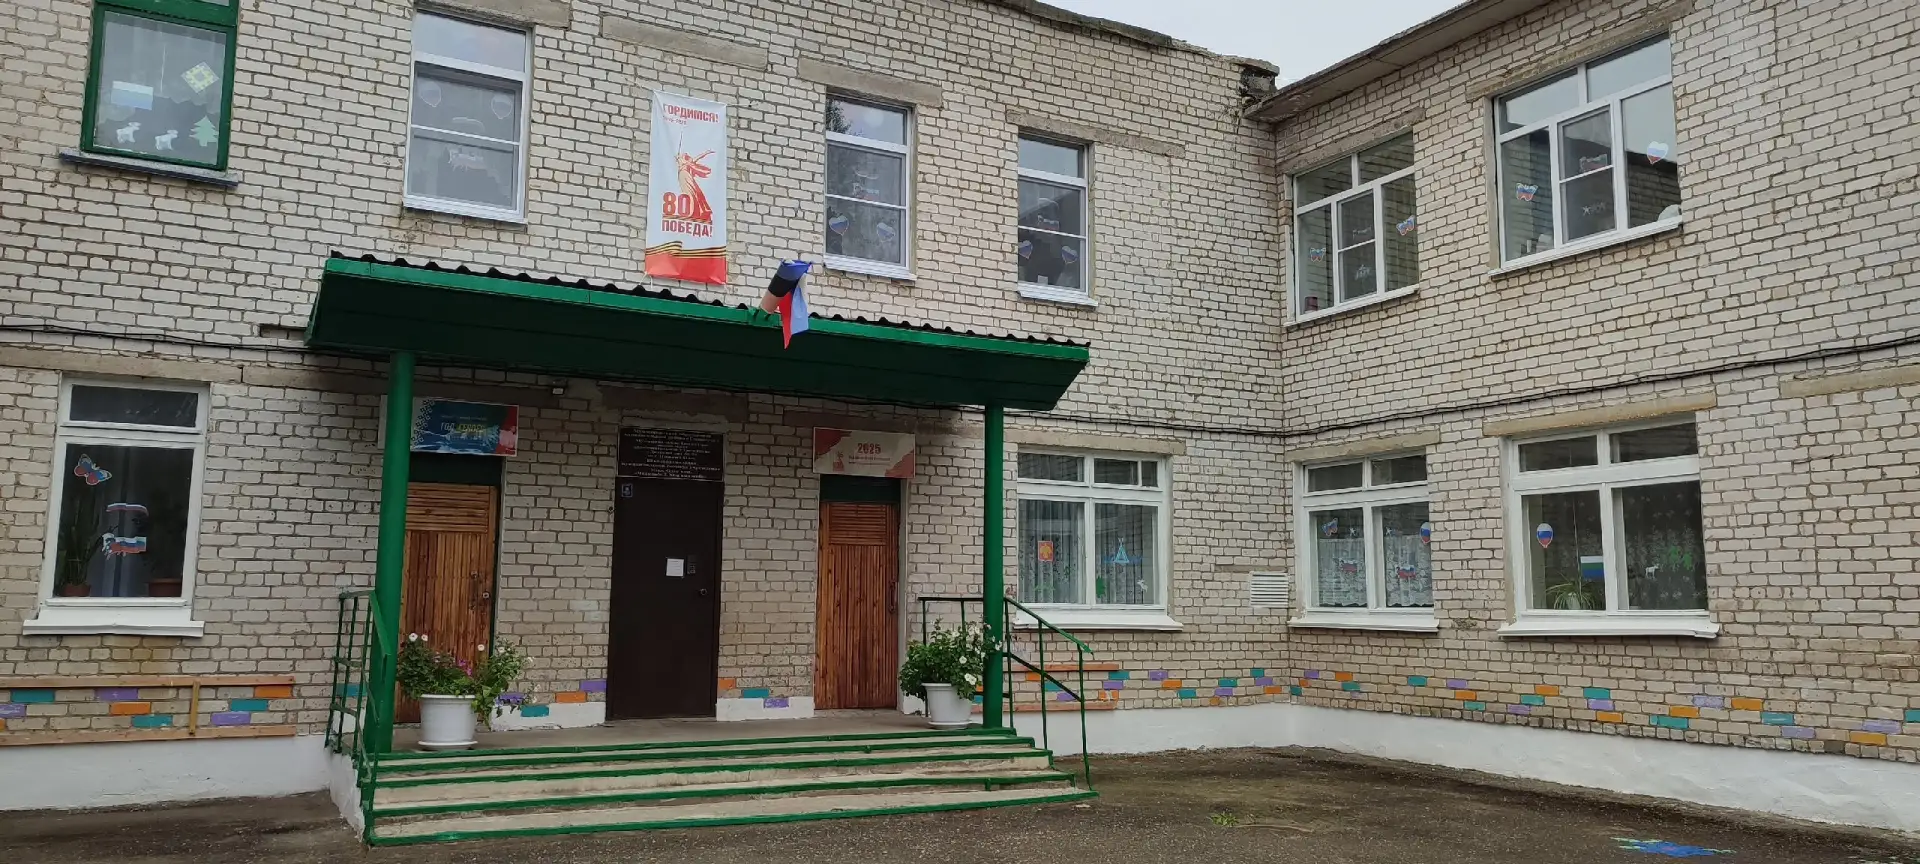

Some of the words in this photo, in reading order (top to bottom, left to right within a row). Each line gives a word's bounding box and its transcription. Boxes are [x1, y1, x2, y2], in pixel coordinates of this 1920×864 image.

[663, 103, 719, 123] ГОРДИМСЯ!
[662, 192, 691, 217] 80
[661, 220, 713, 238] ПОБЕДА!
[858, 442, 881, 455] 2025
